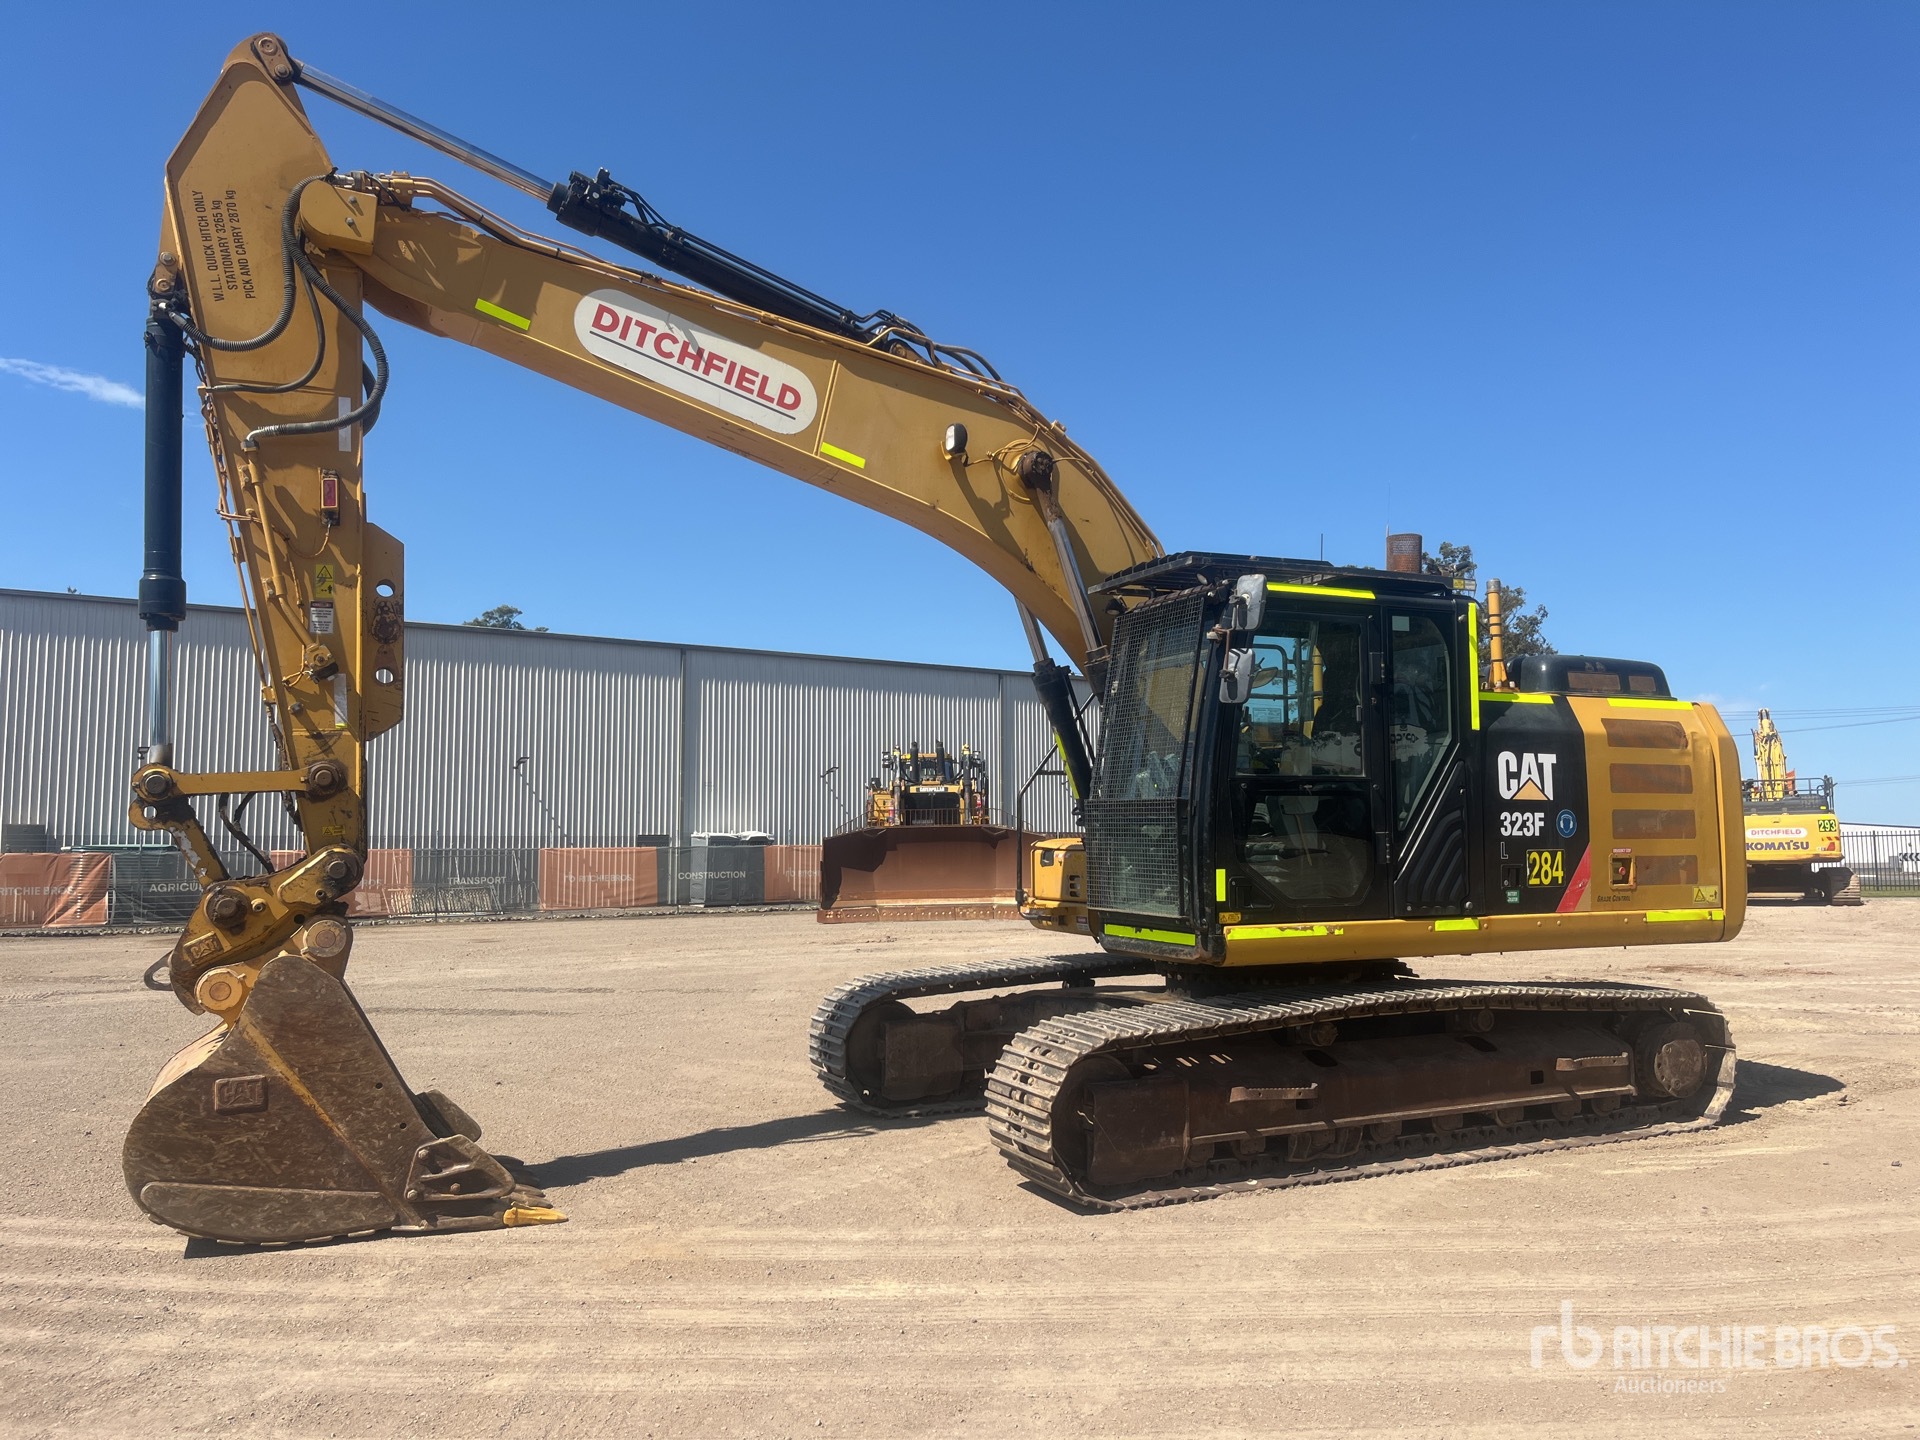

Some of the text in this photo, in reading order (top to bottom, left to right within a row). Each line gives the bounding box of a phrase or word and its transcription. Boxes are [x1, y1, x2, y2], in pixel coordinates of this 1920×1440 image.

[192, 191, 225, 302] W.L.L. QUICK HITCH ONLY
[211, 200, 238, 290] STATIONARY 3265 kg
[225, 190, 256, 299] PICK AND CARRY 2870 kg
[591, 304, 802, 411] DITCHFIELD
[1498, 751, 1556, 801] CAT
[1500, 812, 1545, 837] 323F
[1751, 828, 1802, 836] DITCHFIELD
[1819, 820, 1836, 832] 293
[1500, 842, 1508, 859] L
[1746, 840, 1810, 850] KOMATSU
[678, 870, 746, 880] CONSTRUCTION
[1529, 851, 1564, 885] 284
[447, 876, 506, 885] TRANSPORT
[191, 939, 215, 960] CAT
